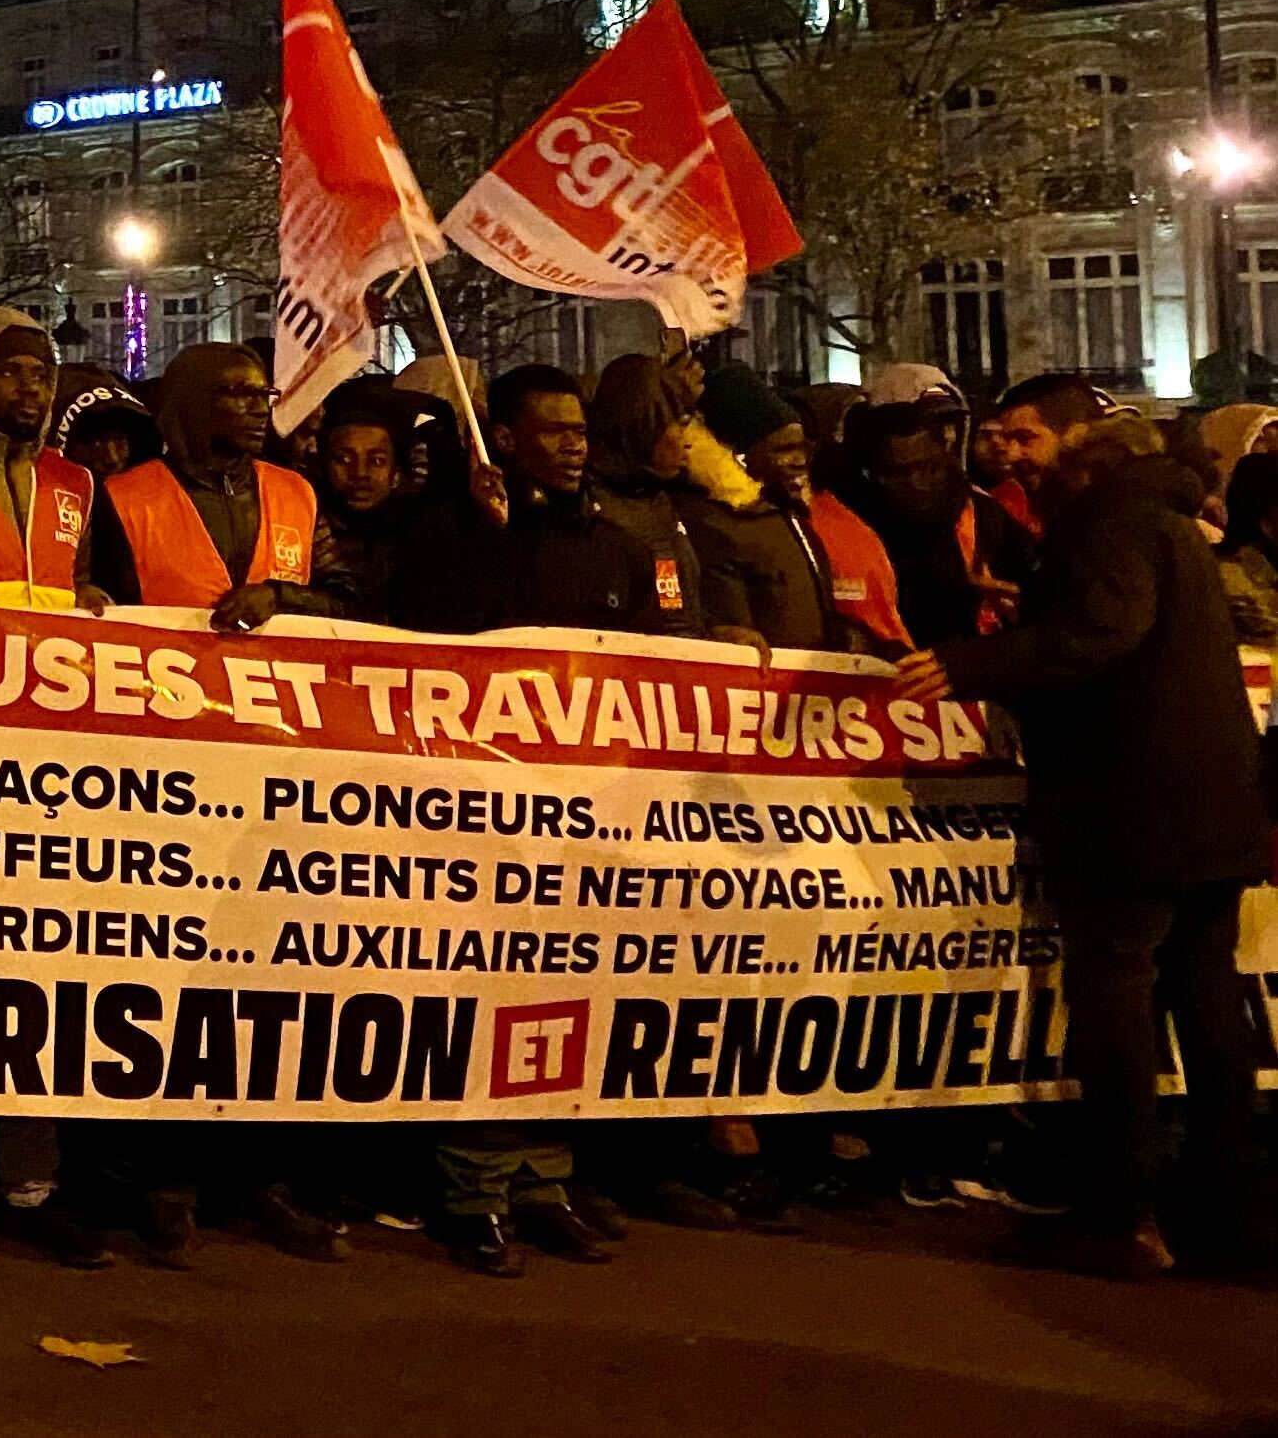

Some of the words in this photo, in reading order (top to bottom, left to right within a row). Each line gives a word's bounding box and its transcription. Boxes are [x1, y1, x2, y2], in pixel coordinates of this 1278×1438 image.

[64, 89, 150, 122] CROWNE
[153, 81, 222, 111] PLAZA
[223, 656, 326, 730] ET
[351, 665, 884, 762] TRAVAILLEURS
[263, 777, 632, 843] PLONGEURS...
[643, 800, 756, 843] AIDES
[257, 848, 479, 903] AGENTS
[493, 862, 565, 906] DE
[578, 866, 885, 910] NETTOYAGE...
[271, 922, 601, 974] AUXILIAIRES
[612, 933, 679, 974] DE
[691, 933, 800, 975] VIE...
[812, 919, 1063, 975] MÉNAGÈRES
[507, 1017, 574, 1084] ET
